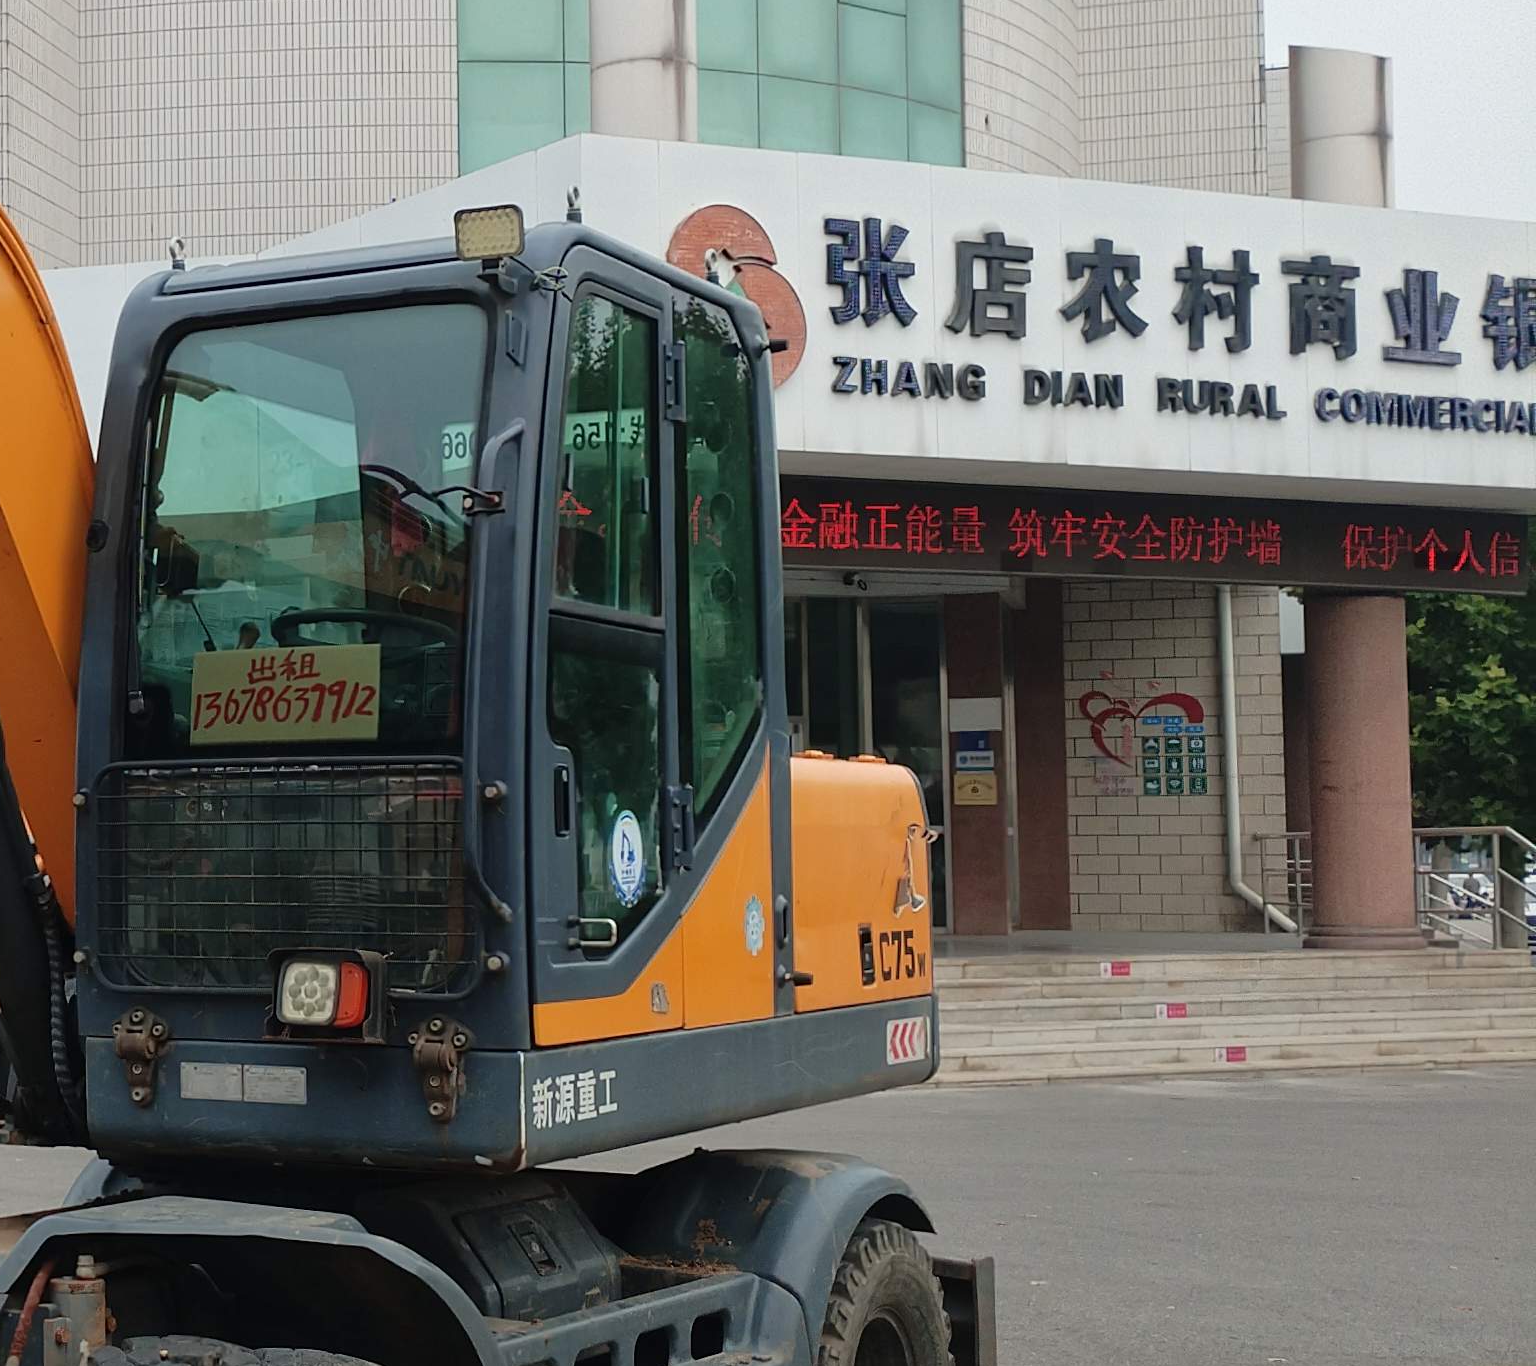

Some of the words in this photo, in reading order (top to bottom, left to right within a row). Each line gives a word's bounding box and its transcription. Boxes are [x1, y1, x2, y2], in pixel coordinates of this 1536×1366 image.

[824, 218, 1536, 372] 张店农村商业银
[831, 356, 986, 401] ZHANG
[1023, 369, 1124, 409] DIAN
[1156, 376, 1288, 421] RURAL
[780, 498, 987, 556] 金融正能量
[1008, 506, 1283, 567] 筑牢安全防护墙
[1341, 523, 1521, 578] 保护个人信
[246, 649, 320, 684] 出租
[532, 1069, 618, 1130] 新源重工
